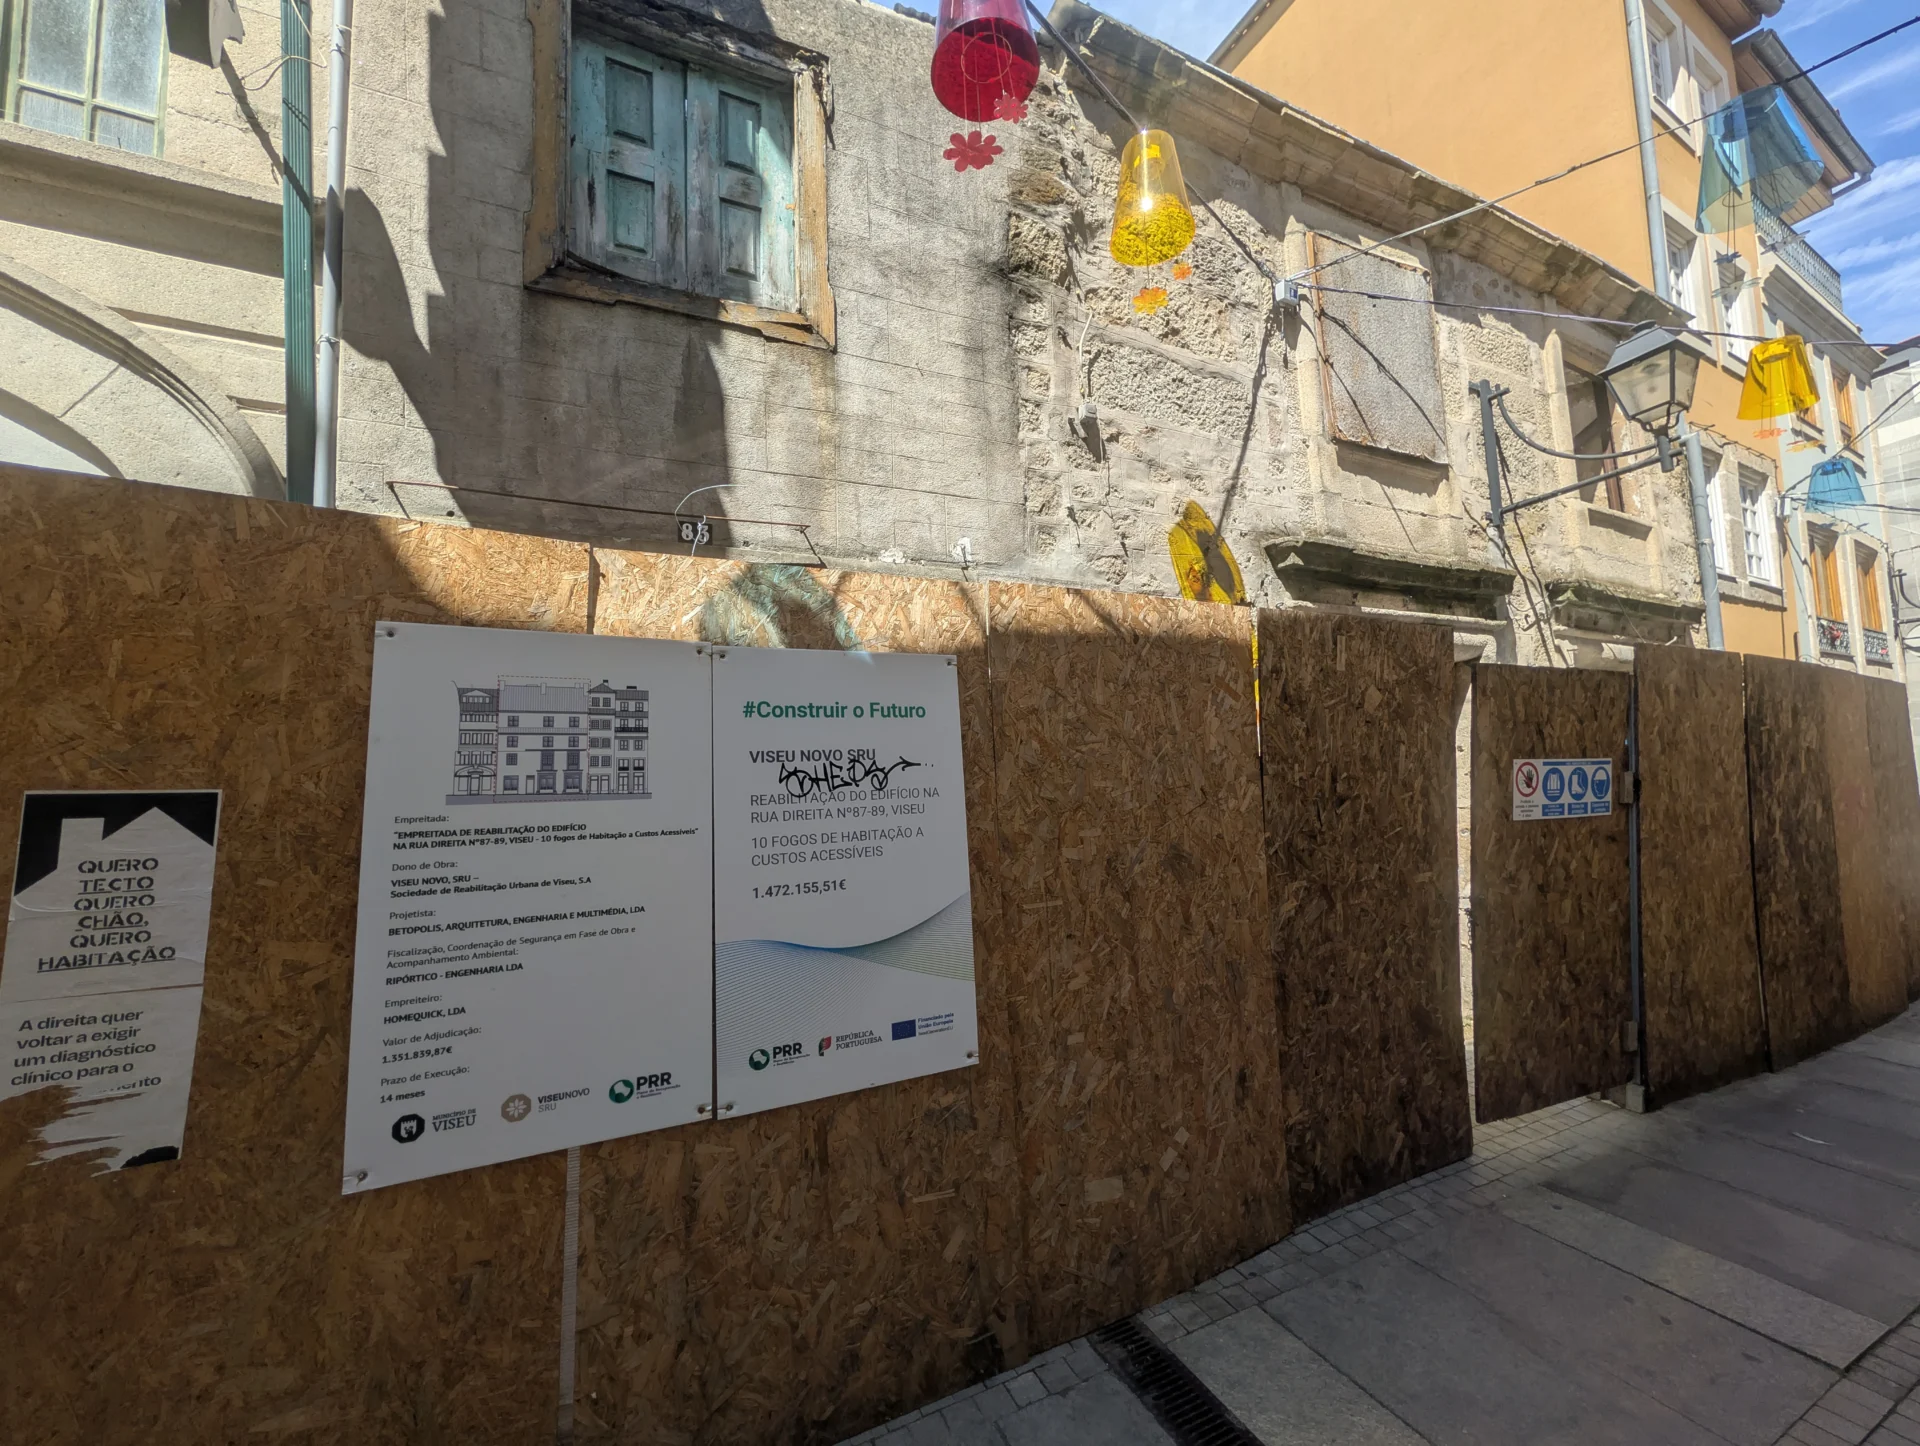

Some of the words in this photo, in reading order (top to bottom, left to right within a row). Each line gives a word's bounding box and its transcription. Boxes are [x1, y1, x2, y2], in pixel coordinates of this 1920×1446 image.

[742, 701, 848, 718] #Construir
[852, 705, 864, 718] o
[869, 702, 926, 718] Futuro
[749, 750, 796, 764] VISEU
[800, 749, 843, 763] NOVO
[847, 748, 876, 762] SRU
[849, 790, 867, 801] DO
[870, 786, 920, 800] EDIFÍCIO
[923, 787, 939, 798] NA
[394, 814, 449, 825] Empreitada:
[751, 810, 779, 824] RUA
[782, 808, 834, 822] DIREITA
[890, 803, 925, 815] VISEU
[459, 828, 472, 836] DE
[473, 825, 536, 836] REABILITAÇÃO
[537, 825, 550, 833] DO
[551, 823, 587, 832] EDIFÍCIO
[751, 836, 768, 849] 10
[771, 833, 818, 848] FOGOS
[820, 832, 838, 844] DE
[841, 825, 912, 842] HABITAÇÃO
[915, 826, 924, 837] A
[392, 842, 407, 850] NA
[408, 840, 429, 849] RUA
[430, 839, 467, 848] DIREITA
[508, 835, 534, 844] VISEU
[541, 834, 552, 842] 10
[553, 834, 576, 843] fogos
[588, 831, 627, 840] Habitação
[634, 830, 659, 838] Custos
[751, 851, 806, 867] CUSTOS
[809, 845, 883, 862] ACESSÍVEIS
[78, 858, 159, 874] QUERO
[391, 863, 417, 872] Dono
[419, 862, 431, 870] de
[433, 860, 458, 869] Obra:
[77, 876, 154, 892] TECTO
[390, 878, 419, 887] VISEU
[421, 876, 451, 885] NOVO,
[452, 874, 471, 883] SRU
[390, 887, 438, 898] Sociedade
[439, 886, 452, 894] de
[453, 882, 507, 893] Reabilitação
[508, 881, 539, 889] Urbana
[540, 879, 551, 887] de
[552, 878, 577, 886] Viseu,
[578, 876, 592, 884] S.A
[752, 878, 846, 899] 1.472.155,51€
[74, 894, 155, 911] QUERO
[77, 911, 149, 932] CHÃO,
[388, 924, 444, 936] BETOPOLIS,
[444, 918, 512, 931] ARQUITETURA,
[512, 912, 568, 924] ENGENHARIA
[569, 911, 575, 919] E
[576, 907, 629, 919] MULTIMÉDIA,
[630, 905, 645, 914] LDA
[389, 910, 436, 921] Projetista:
[70, 930, 151, 948] QUERO
[387, 945, 446, 958] Fiscalização,
[447, 939, 504, 952] Coordenação
[505, 938, 517, 946] de
[519, 934, 562, 945] Segurança
[578, 930, 597, 938] Fase
[598, 928, 609, 936] de
[610, 927, 629, 935] Obra
[37, 945, 176, 971] HABITAÇÃO
[386, 954, 470, 969] Acompanhamento
[471, 948, 518, 960] Ambiental:
[385, 972, 438, 986] RIPÓRTICO
[445, 964, 504, 979] ENGENHARIA
[505, 962, 524, 972] LDA
[384, 994, 442, 1008] Empreiteiro:
[18, 1020, 33, 1032] A
[37, 1014, 97, 1030] direita
[101, 1011, 144, 1025] quer
[383, 1009, 446, 1025] HOMEQUICK,
[447, 1006, 466, 1016] LDA
[16, 1035, 73, 1049] voltar
[76, 1033, 87, 1043] a
[91, 1026, 141, 1046] exigir
[382, 1037, 408, 1047] Valor
[409, 1035, 422, 1043] de
[423, 1026, 482, 1041] Adjudicação:
[836, 1030, 874, 1043] REPÚBLICA
[836, 1036, 883, 1050] PORTUGUESA
[14, 1055, 46, 1068] um
[50, 1042, 156, 1063] diagnóstico
[382, 1045, 452, 1064] 1.351.839,87€
[773, 1042, 802, 1059] PRR
[11, 1069, 73, 1088] clínico
[76, 1064, 119, 1080] para
[122, 1063, 134, 1072] o
[380, 1076, 407, 1087] Prazo
[409, 1073, 422, 1082] de
[424, 1066, 470, 1080] Execução:
[636, 1072, 672, 1091] PRR
[380, 1094, 393, 1104] 14
[395, 1090, 426, 1101] meses
[538, 1103, 557, 1113] SRU
[432, 1114, 476, 1132] VISEU
